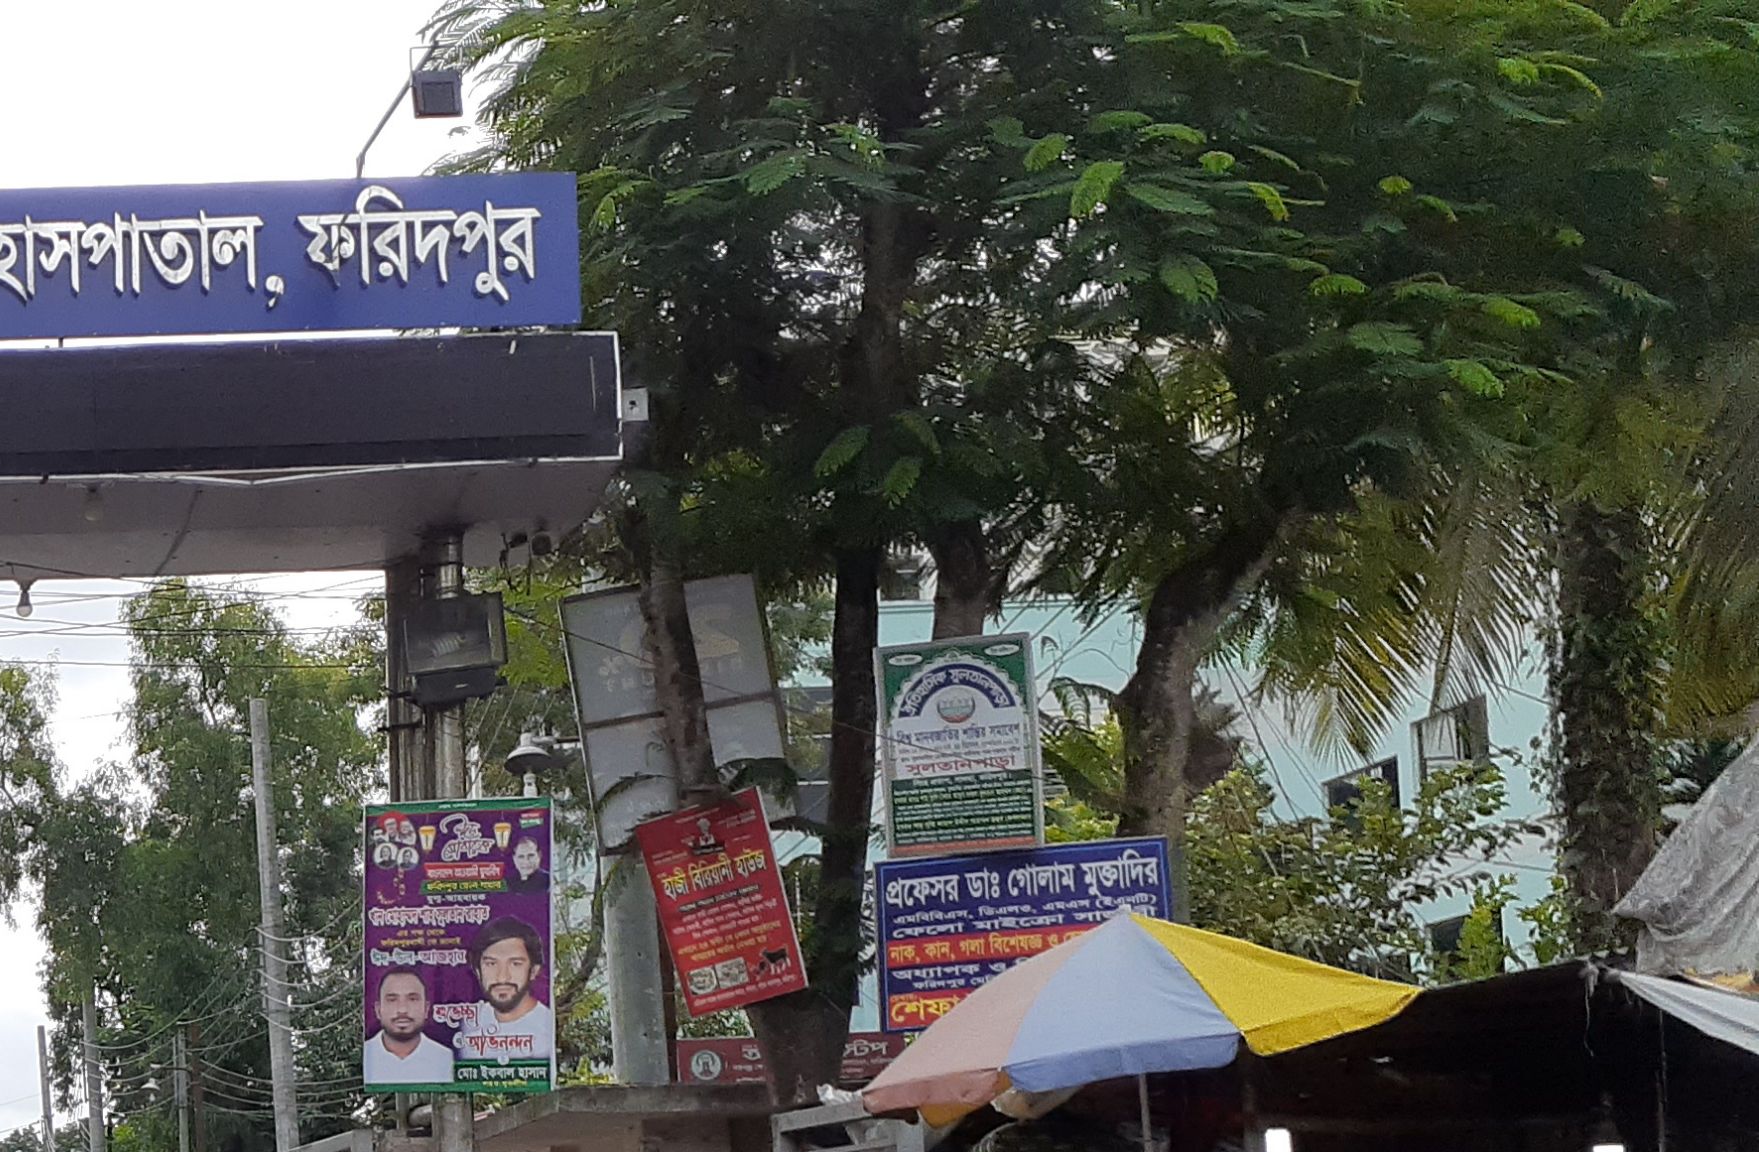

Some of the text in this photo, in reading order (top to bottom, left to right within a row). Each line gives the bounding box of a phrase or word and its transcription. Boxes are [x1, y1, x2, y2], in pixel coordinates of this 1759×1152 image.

[298, 185, 542, 302] ফরিদপুর
[662, 867, 689, 900] হাজী
[885, 849, 1159, 908] প্রফেসর ডাঃ গোলাম মুক্তাদির
[893, 920, 964, 939] ফেলো
[890, 945, 920, 963] নাক,
[925, 940, 955, 960] কান,
[960, 937, 985, 955] গলা
[892, 963, 980, 980] অধ্যাপক
[913, 977, 965, 989] ফরিদপুর
[433, 1002, 479, 1028] শুভেচ্ছা
[465, 1024, 535, 1056] অভিনন্দন
